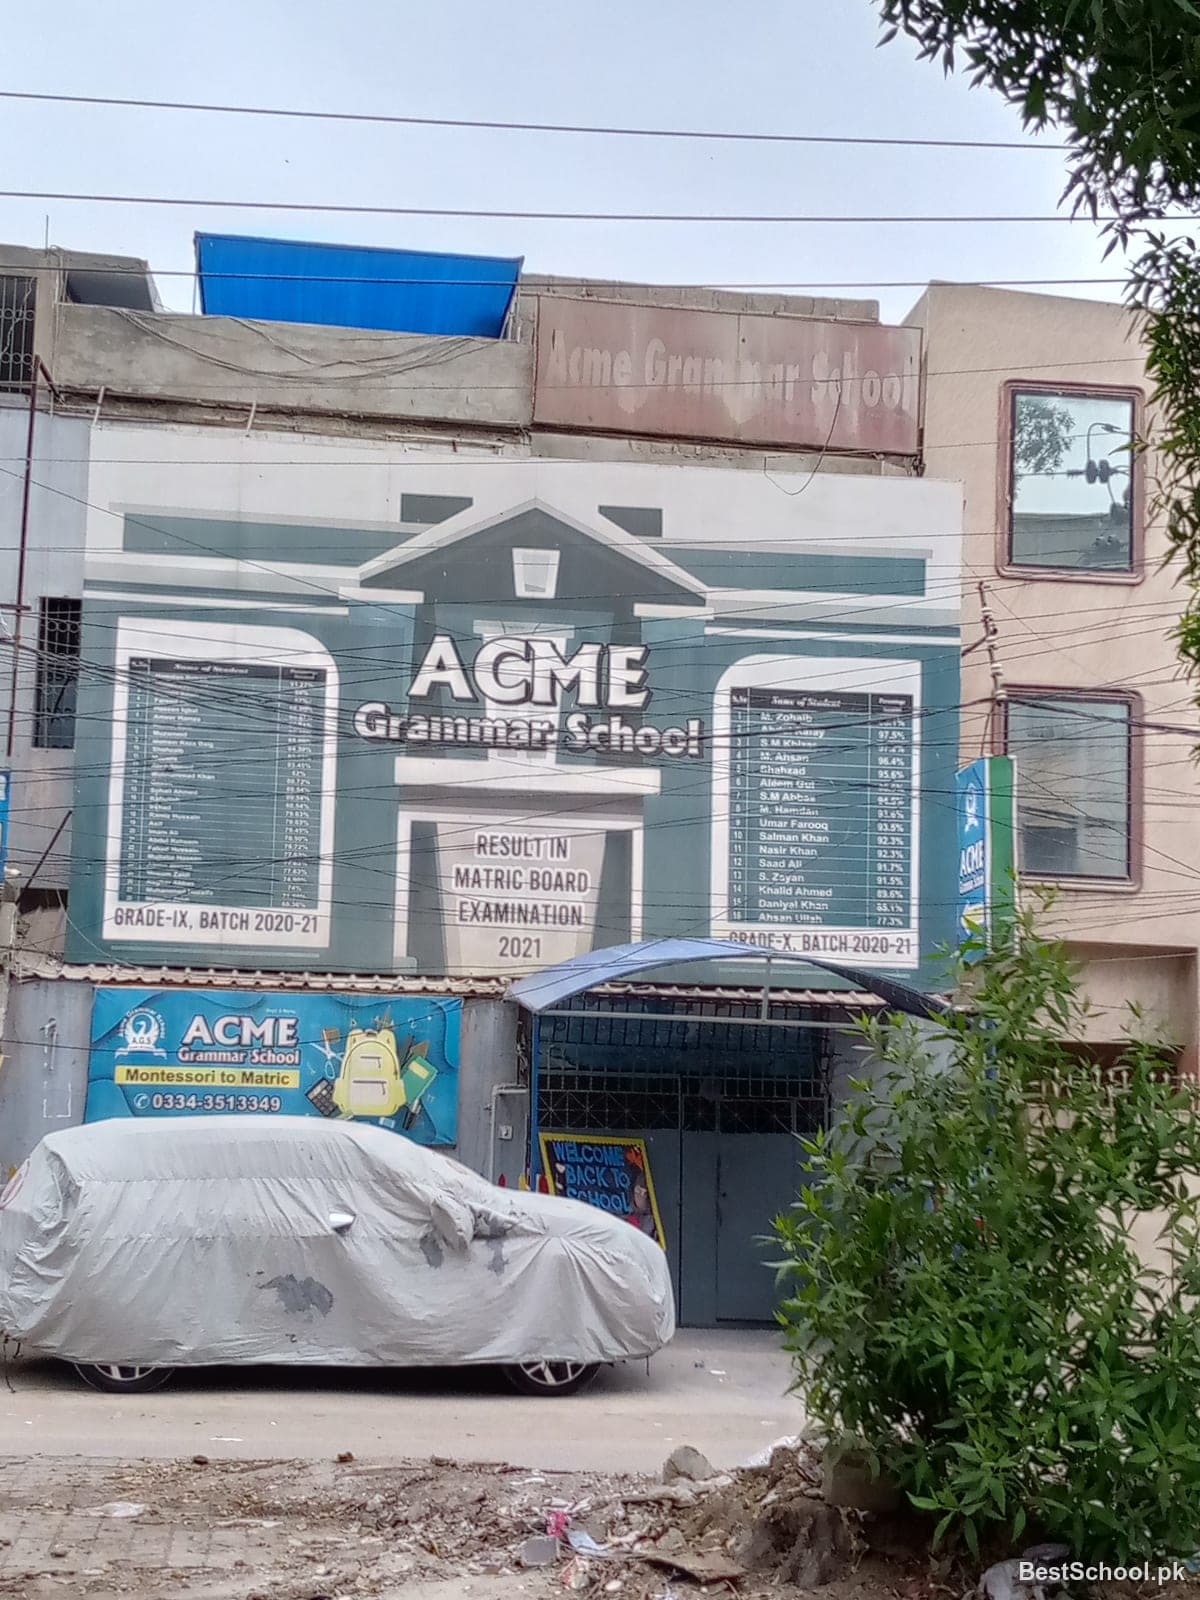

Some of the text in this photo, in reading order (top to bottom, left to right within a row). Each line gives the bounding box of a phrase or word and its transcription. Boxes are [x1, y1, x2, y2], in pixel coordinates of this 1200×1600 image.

[407, 634, 653, 711] ACME
[353, 701, 555, 751] Grammar
[564, 713, 704, 759] School
[760, 765, 806, 775] Shahzad
[760, 818, 788, 828] Umar
[790, 820, 829, 831] Farooq
[477, 834, 568, 859] RESULT IN
[759, 831, 799, 841] Salman
[801, 832, 830, 843] Khan
[734, 844, 742, 853] 11
[759, 845, 788, 855] Nasir
[789, 846, 818, 856] Khan
[733, 857, 743, 867] 12
[759, 858, 785, 868] Saad
[787, 859, 803, 869] Ali
[455, 867, 588, 893] MATRIC BOARD
[759, 885, 793, 896] Khalid
[795, 887, 833, 898] Ahmed
[459, 901, 583, 926] EXAMINATION
[759, 899, 799, 911] Daniyal
[801, 900, 829, 911] Khan
[114, 907, 318, 934] GRADE-IX, BATCH 2020-21
[759, 912, 793, 922] Ahsan
[499, 936, 542, 959] 2021
[802, 933, 848, 953] BATCH
[852, 935, 912, 955] 2020-21
[182, 1014, 299, 1048] ACME
[177, 1046, 299, 1065] Grammar School
[126, 1068, 290, 1086] Montessori to Matric
[152, 1093, 282, 1112] 0334-3513349
[552, 1142, 625, 1167] WELCOME
[565, 1163, 631, 1189] BACK TO
